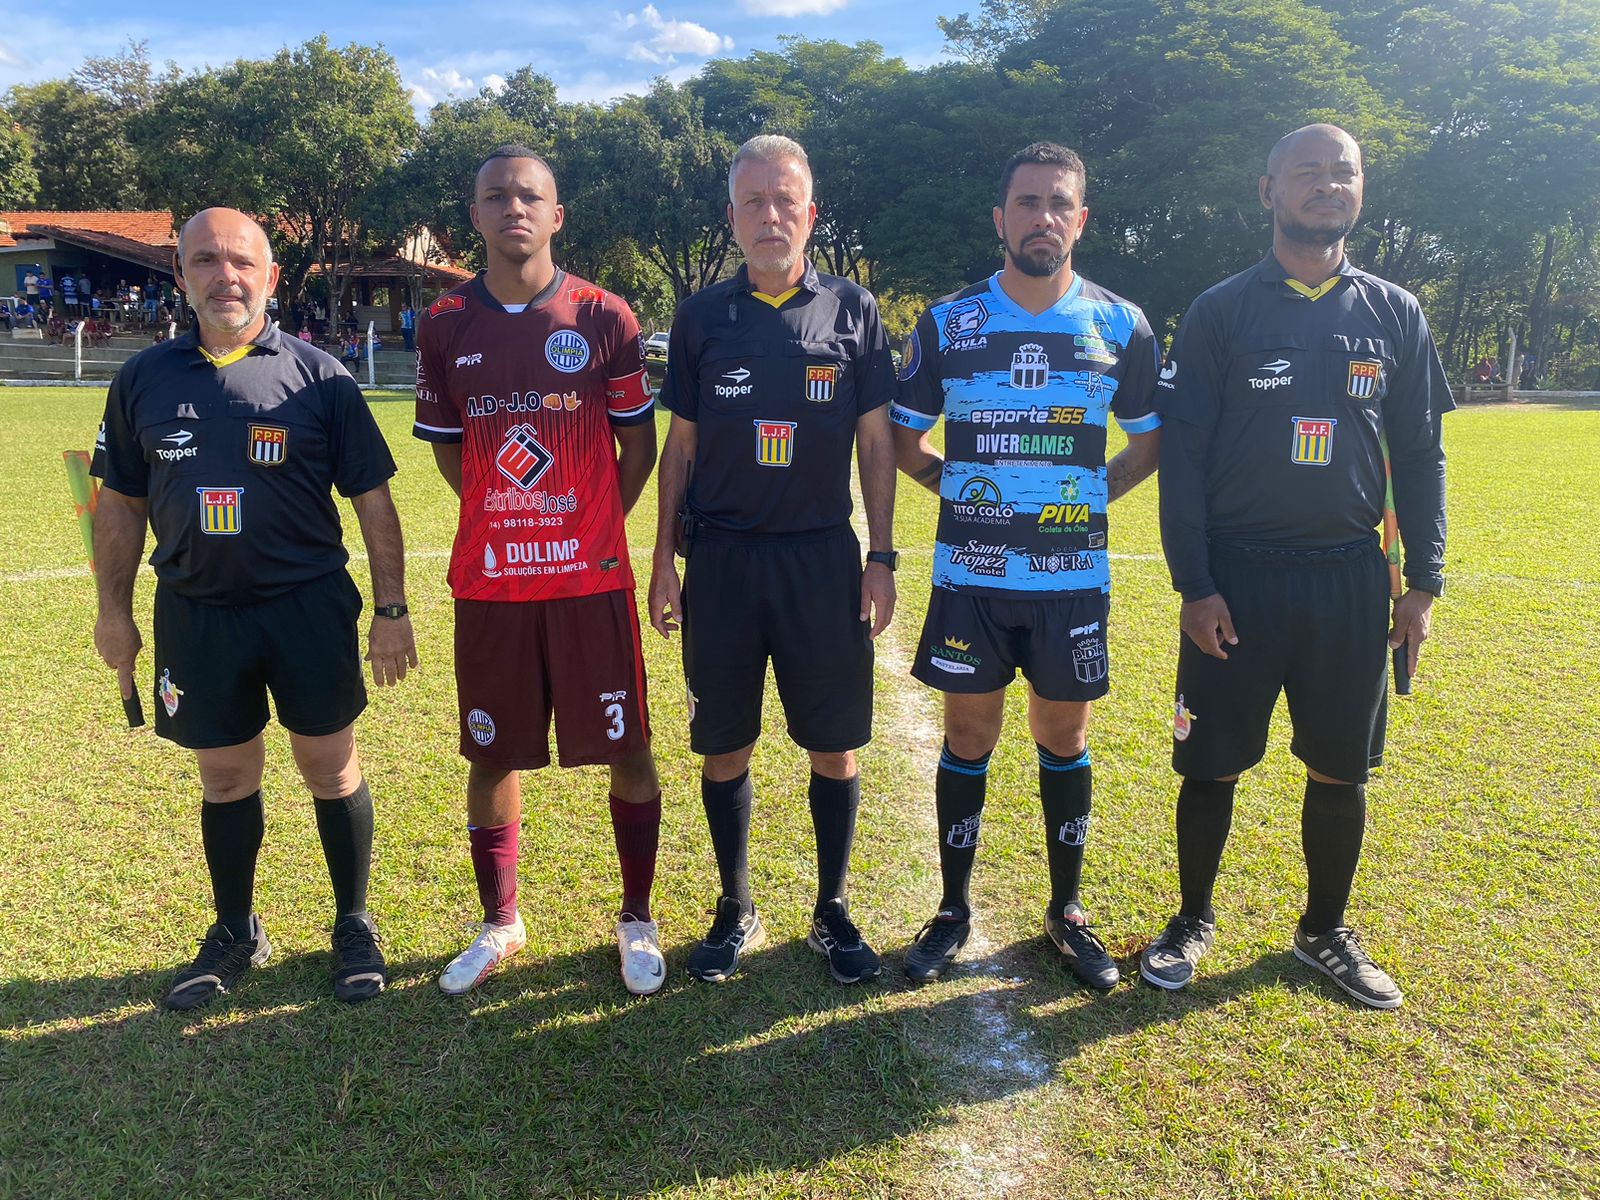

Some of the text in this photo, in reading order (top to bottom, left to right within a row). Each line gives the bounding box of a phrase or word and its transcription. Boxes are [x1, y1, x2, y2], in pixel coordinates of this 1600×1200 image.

[551, 346, 584, 357] OLIMPIA
[1014, 354, 1047, 364] B.D.R
[808, 369, 832, 380] F.P.F.
[1352, 364, 1376, 377] F.P.F.
[1249, 376, 1293, 390] Topper
[715, 384, 753, 398] Topper
[971, 405, 1087, 429] esporte365
[253, 430, 282, 443] F.P.F.
[761, 426, 789, 438] L.J.F.
[1299, 424, 1328, 435] L.J.F.
[976, 434, 1074, 456] DIVERGAMES
[156, 447, 198, 461] Topper
[205, 494, 236, 504] L.J.F.
[953, 505, 1014, 518] TITO COLÓ
[1038, 504, 1090, 524] PIVA
[503, 517, 563, 528] 98118-3923
[506, 539, 580, 563] DULIMP
[964, 540, 1008, 555] Saint
[951, 549, 1008, 571] Tropez
[504, 566, 542, 577] SOLUÇÕES
[556, 561, 589, 575] LIMPEZA
[975, 568, 1005, 576] motel
[929, 645, 983, 666] SANTOS
[605, 703, 625, 741] 3
